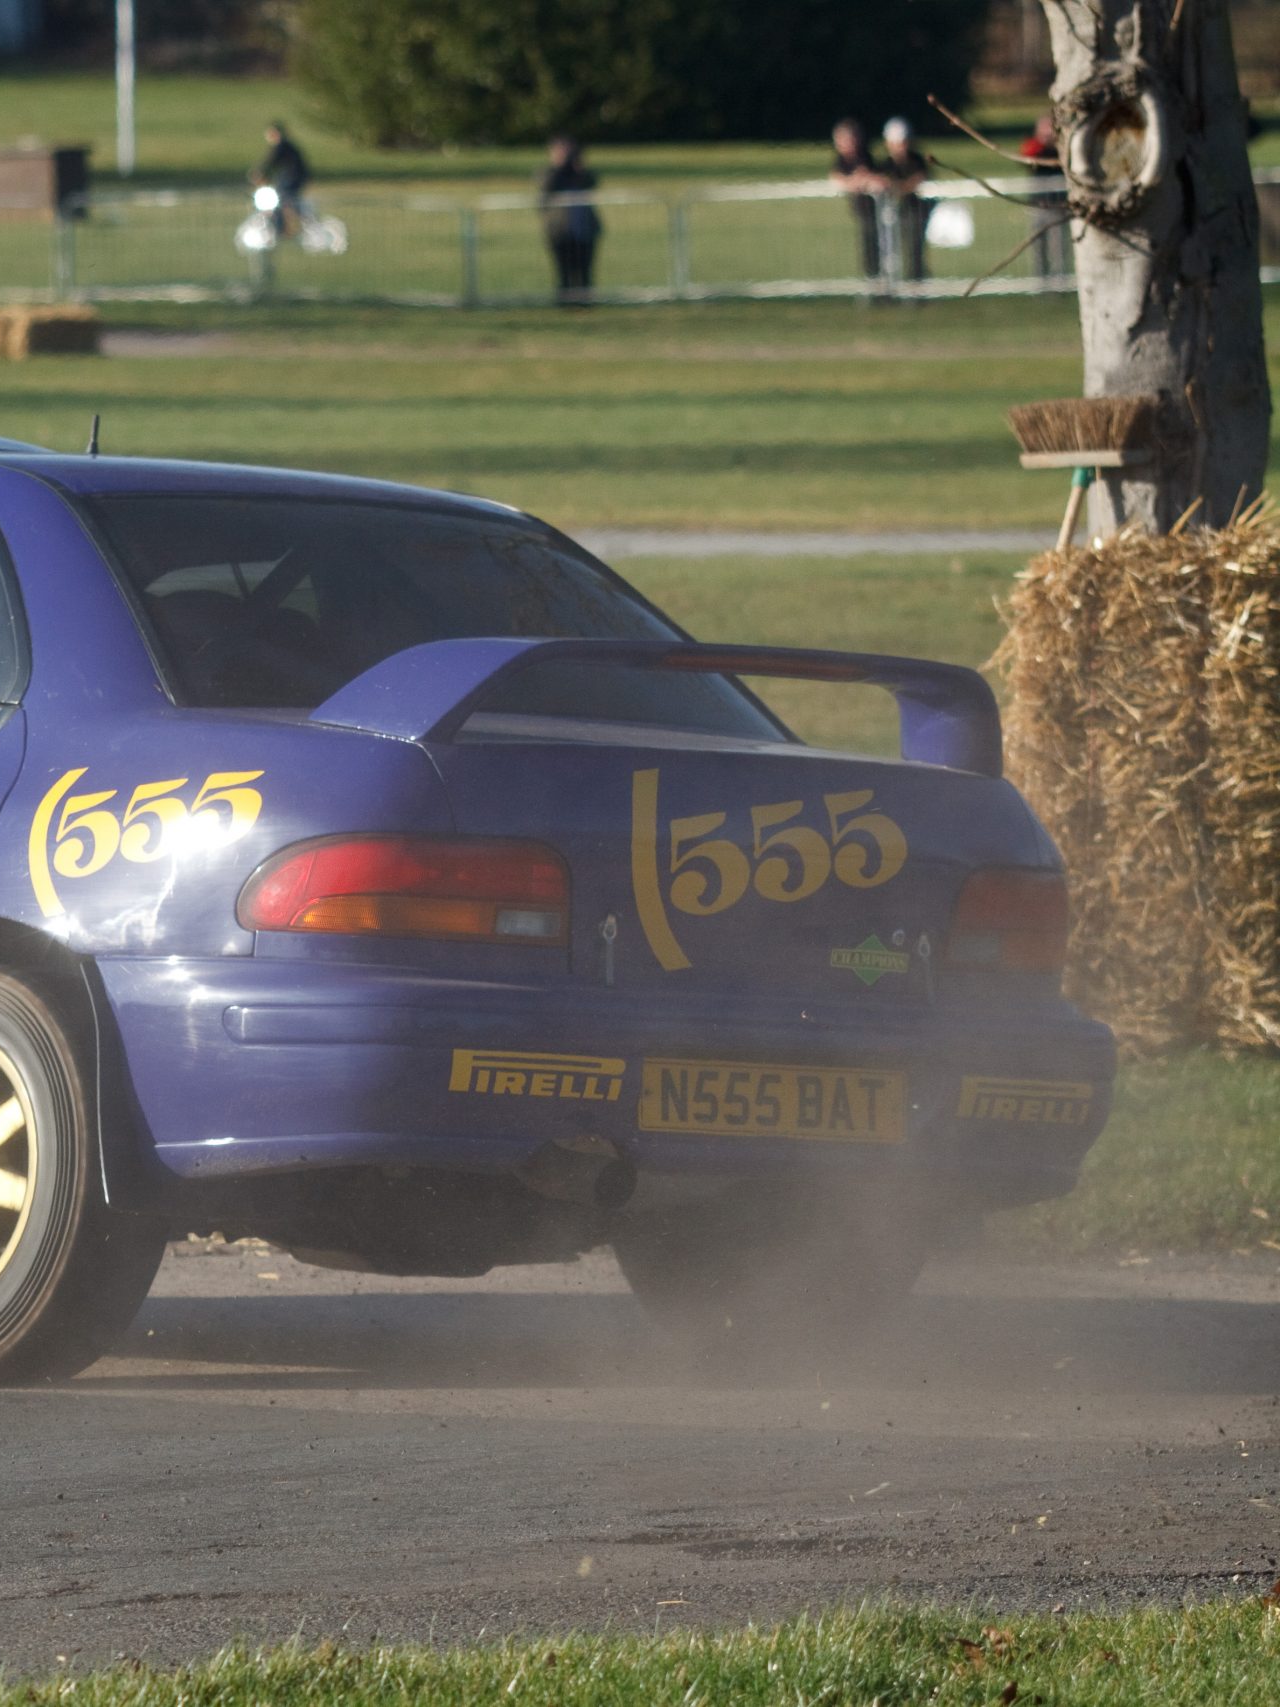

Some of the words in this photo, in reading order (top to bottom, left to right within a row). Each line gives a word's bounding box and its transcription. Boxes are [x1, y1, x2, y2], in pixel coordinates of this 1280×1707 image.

[53, 770, 266, 878] 555
[670, 789, 908, 917] 555
[450, 1049, 626, 1101] PIRELLI
[660, 1067, 782, 1127] N555
[796, 1074, 887, 1132] BAT
[954, 1074, 1094, 1126] PIRELLI
